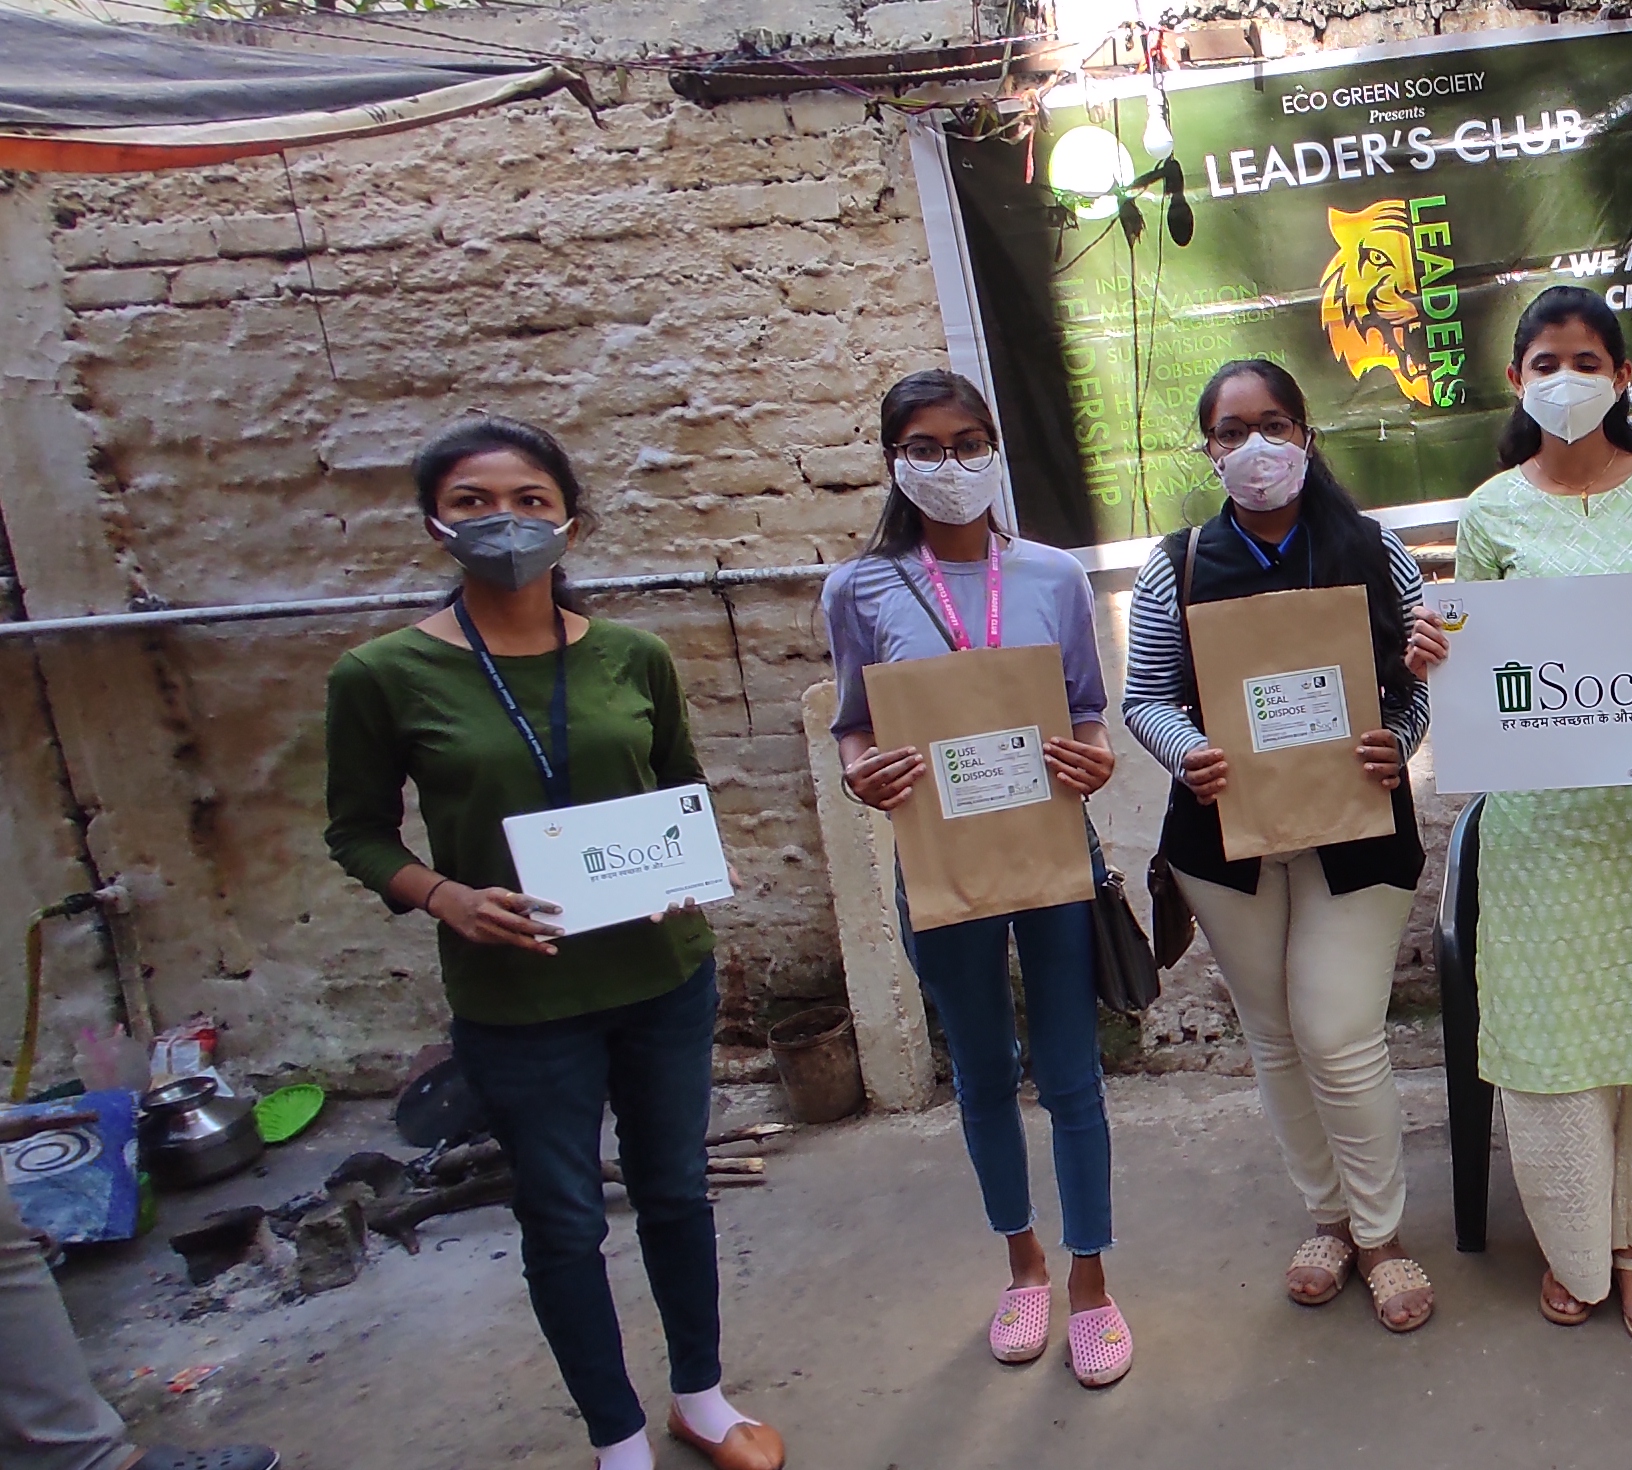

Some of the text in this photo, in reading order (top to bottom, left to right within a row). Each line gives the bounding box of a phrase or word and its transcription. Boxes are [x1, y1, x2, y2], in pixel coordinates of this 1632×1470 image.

[1282, 71, 1486, 115] ECO GREEN SOCIETY
[1368, 105, 1426, 124] Presents
[1205, 108, 1586, 198] LEADER'S CLUB
[1095, 271, 1164, 295] INDAN
[1409, 195, 1467, 408] LEADERS
[1264, 684, 1282, 695] USE
[1266, 696, 1289, 706] SEAL
[1268, 705, 1306, 719] DISPOSE
[1501, 719, 1516, 731] हर
[1520, 716, 1549, 729] कदम
[1552, 714, 1595, 727] स्वच्छता
[1598, 710, 1609, 724] के
[957, 746, 977, 757] USE
[960, 758, 986, 769] SEAL
[962, 767, 1004, 782] DISPOSE
[606, 834, 683, 869] Soch
